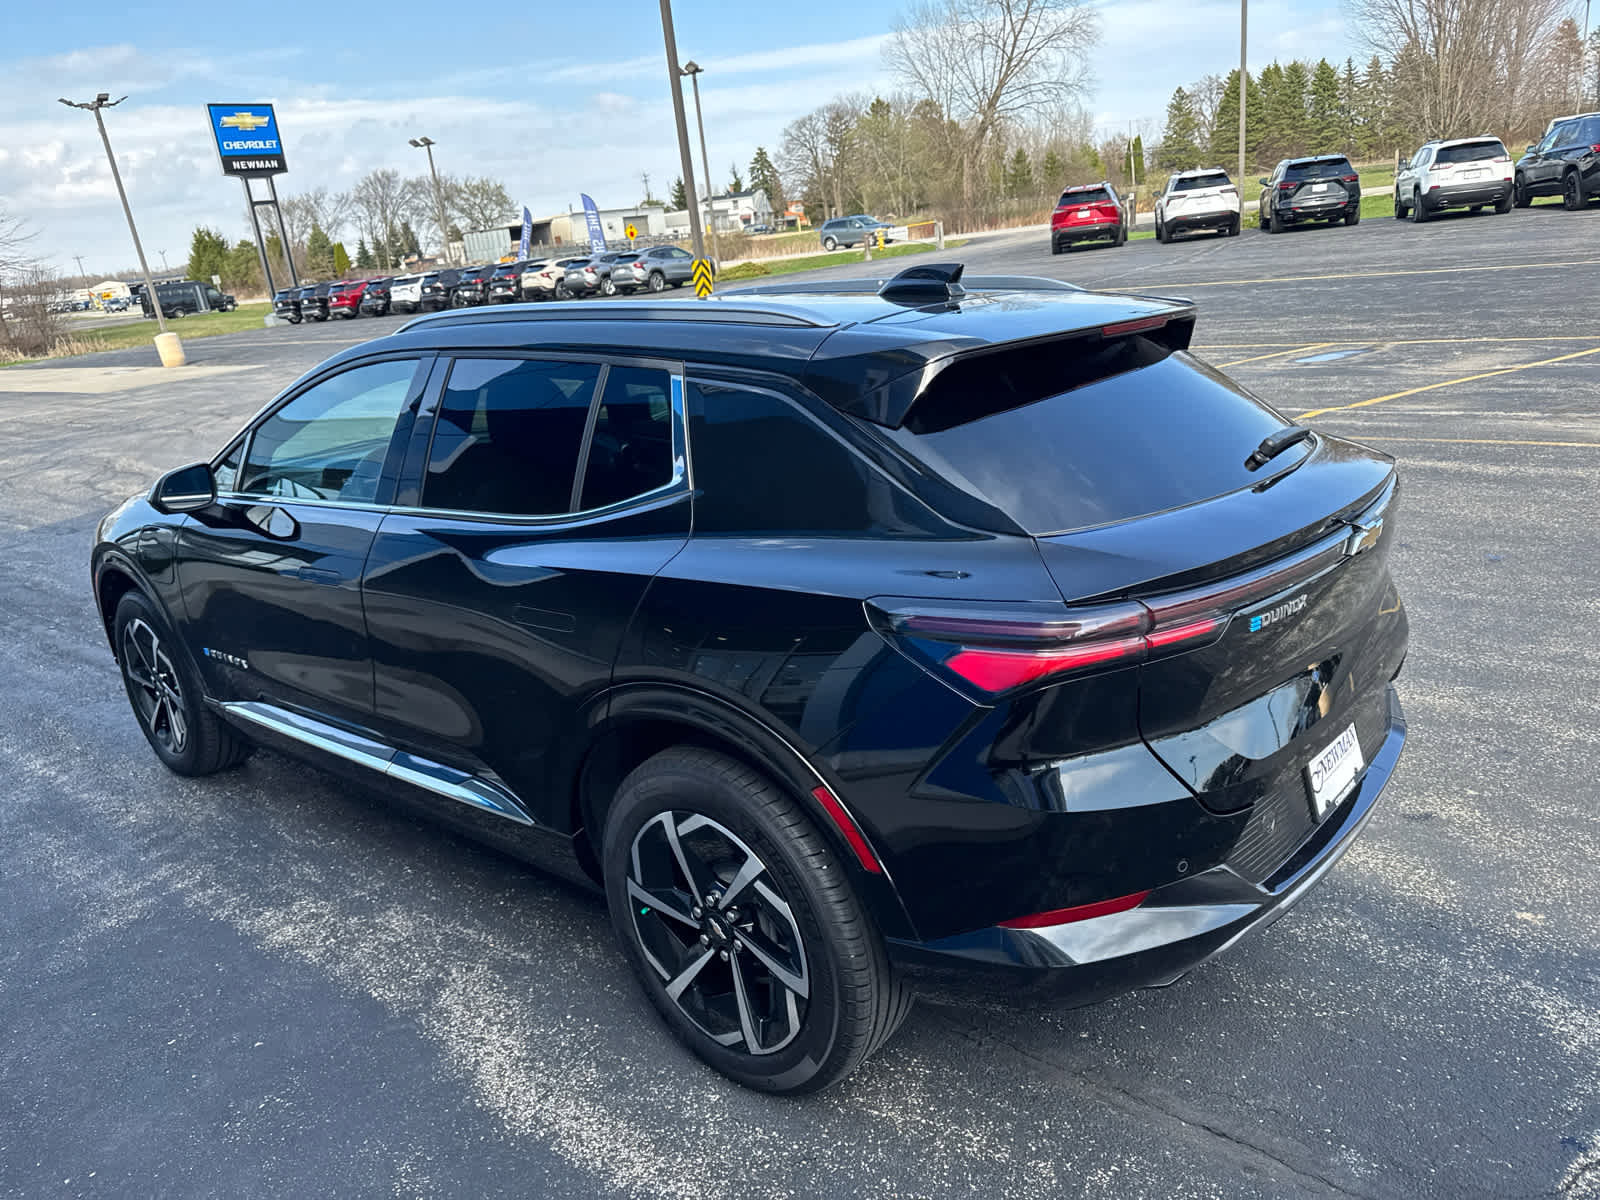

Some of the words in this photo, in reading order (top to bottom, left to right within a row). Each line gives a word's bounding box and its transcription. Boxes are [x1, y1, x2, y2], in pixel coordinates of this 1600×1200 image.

[223, 140, 277, 150] CHEVROLET
[232, 160, 279, 169] NEWMAN
[1312, 727, 1356, 793] NEWMAN
